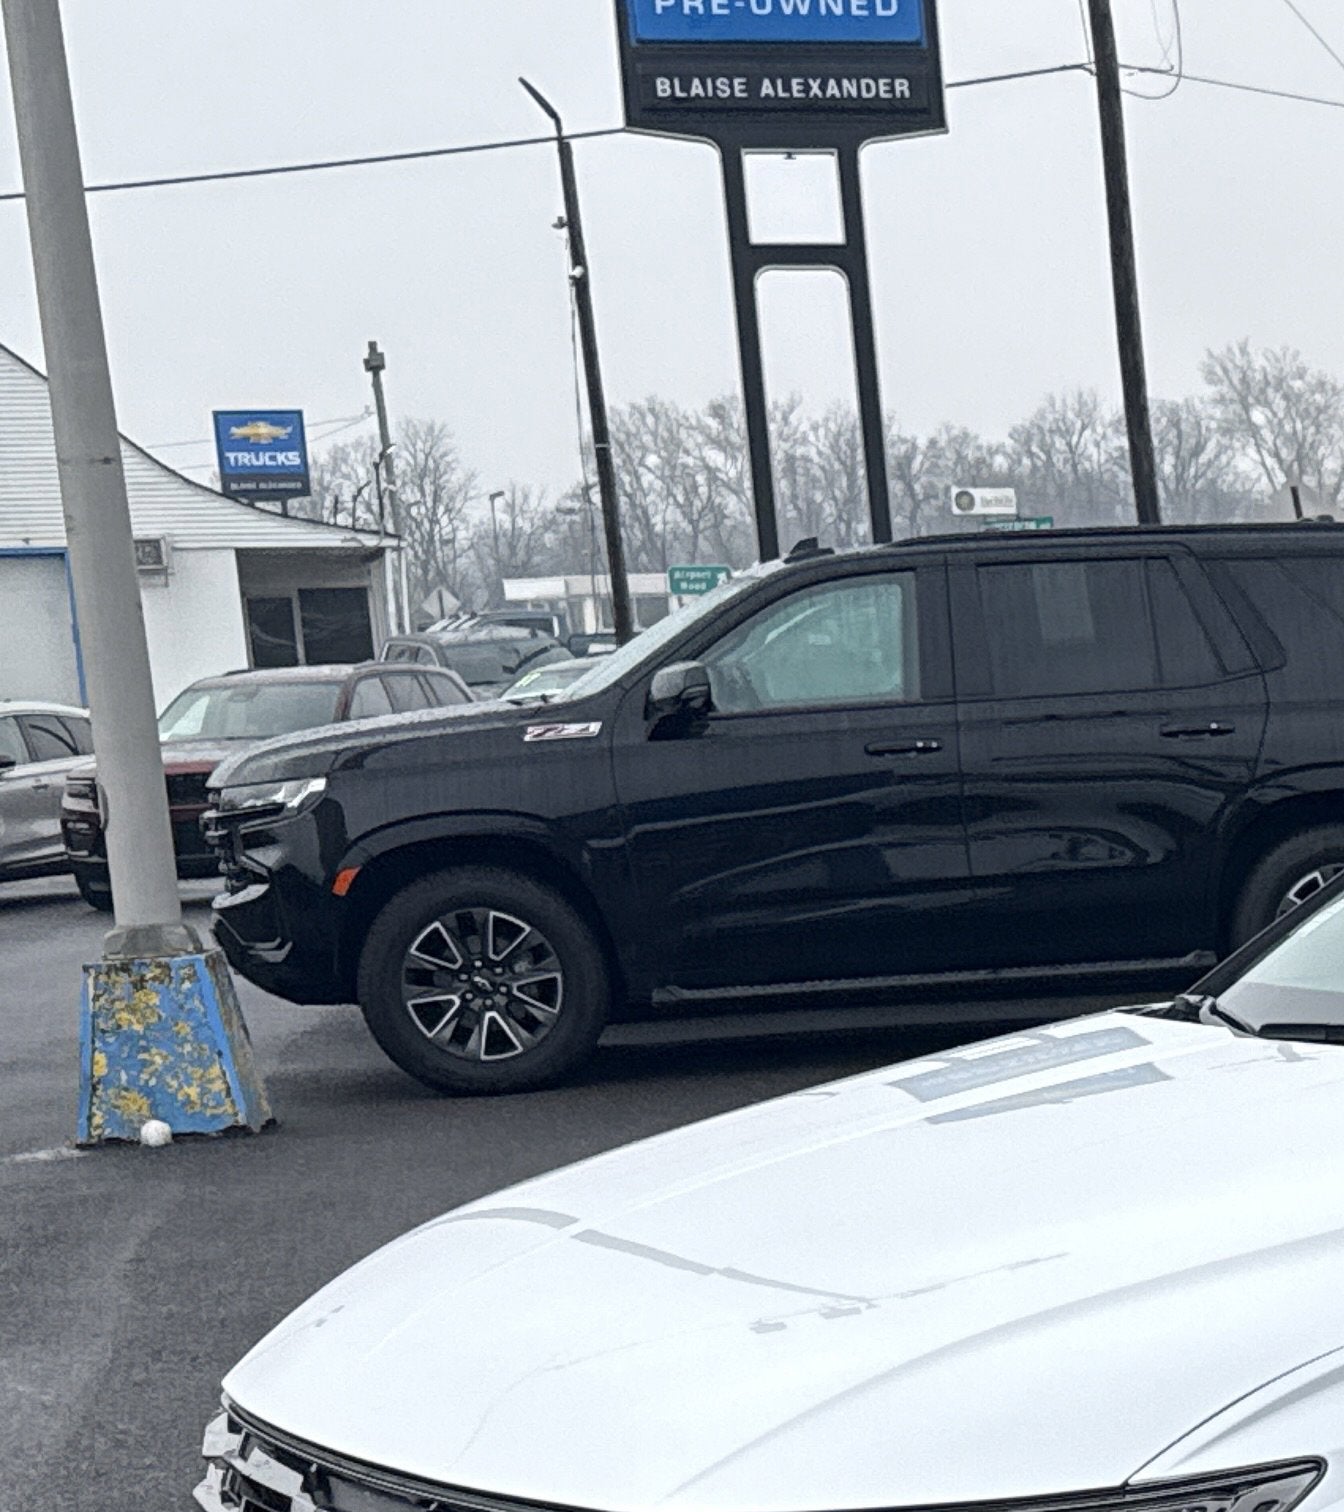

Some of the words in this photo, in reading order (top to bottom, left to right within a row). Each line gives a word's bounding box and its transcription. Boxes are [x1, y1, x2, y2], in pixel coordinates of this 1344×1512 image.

[655, 77, 748, 98] BLAISE
[759, 78, 911, 99] ALEXANDER
[224, 451, 301, 467] TRUCKS
